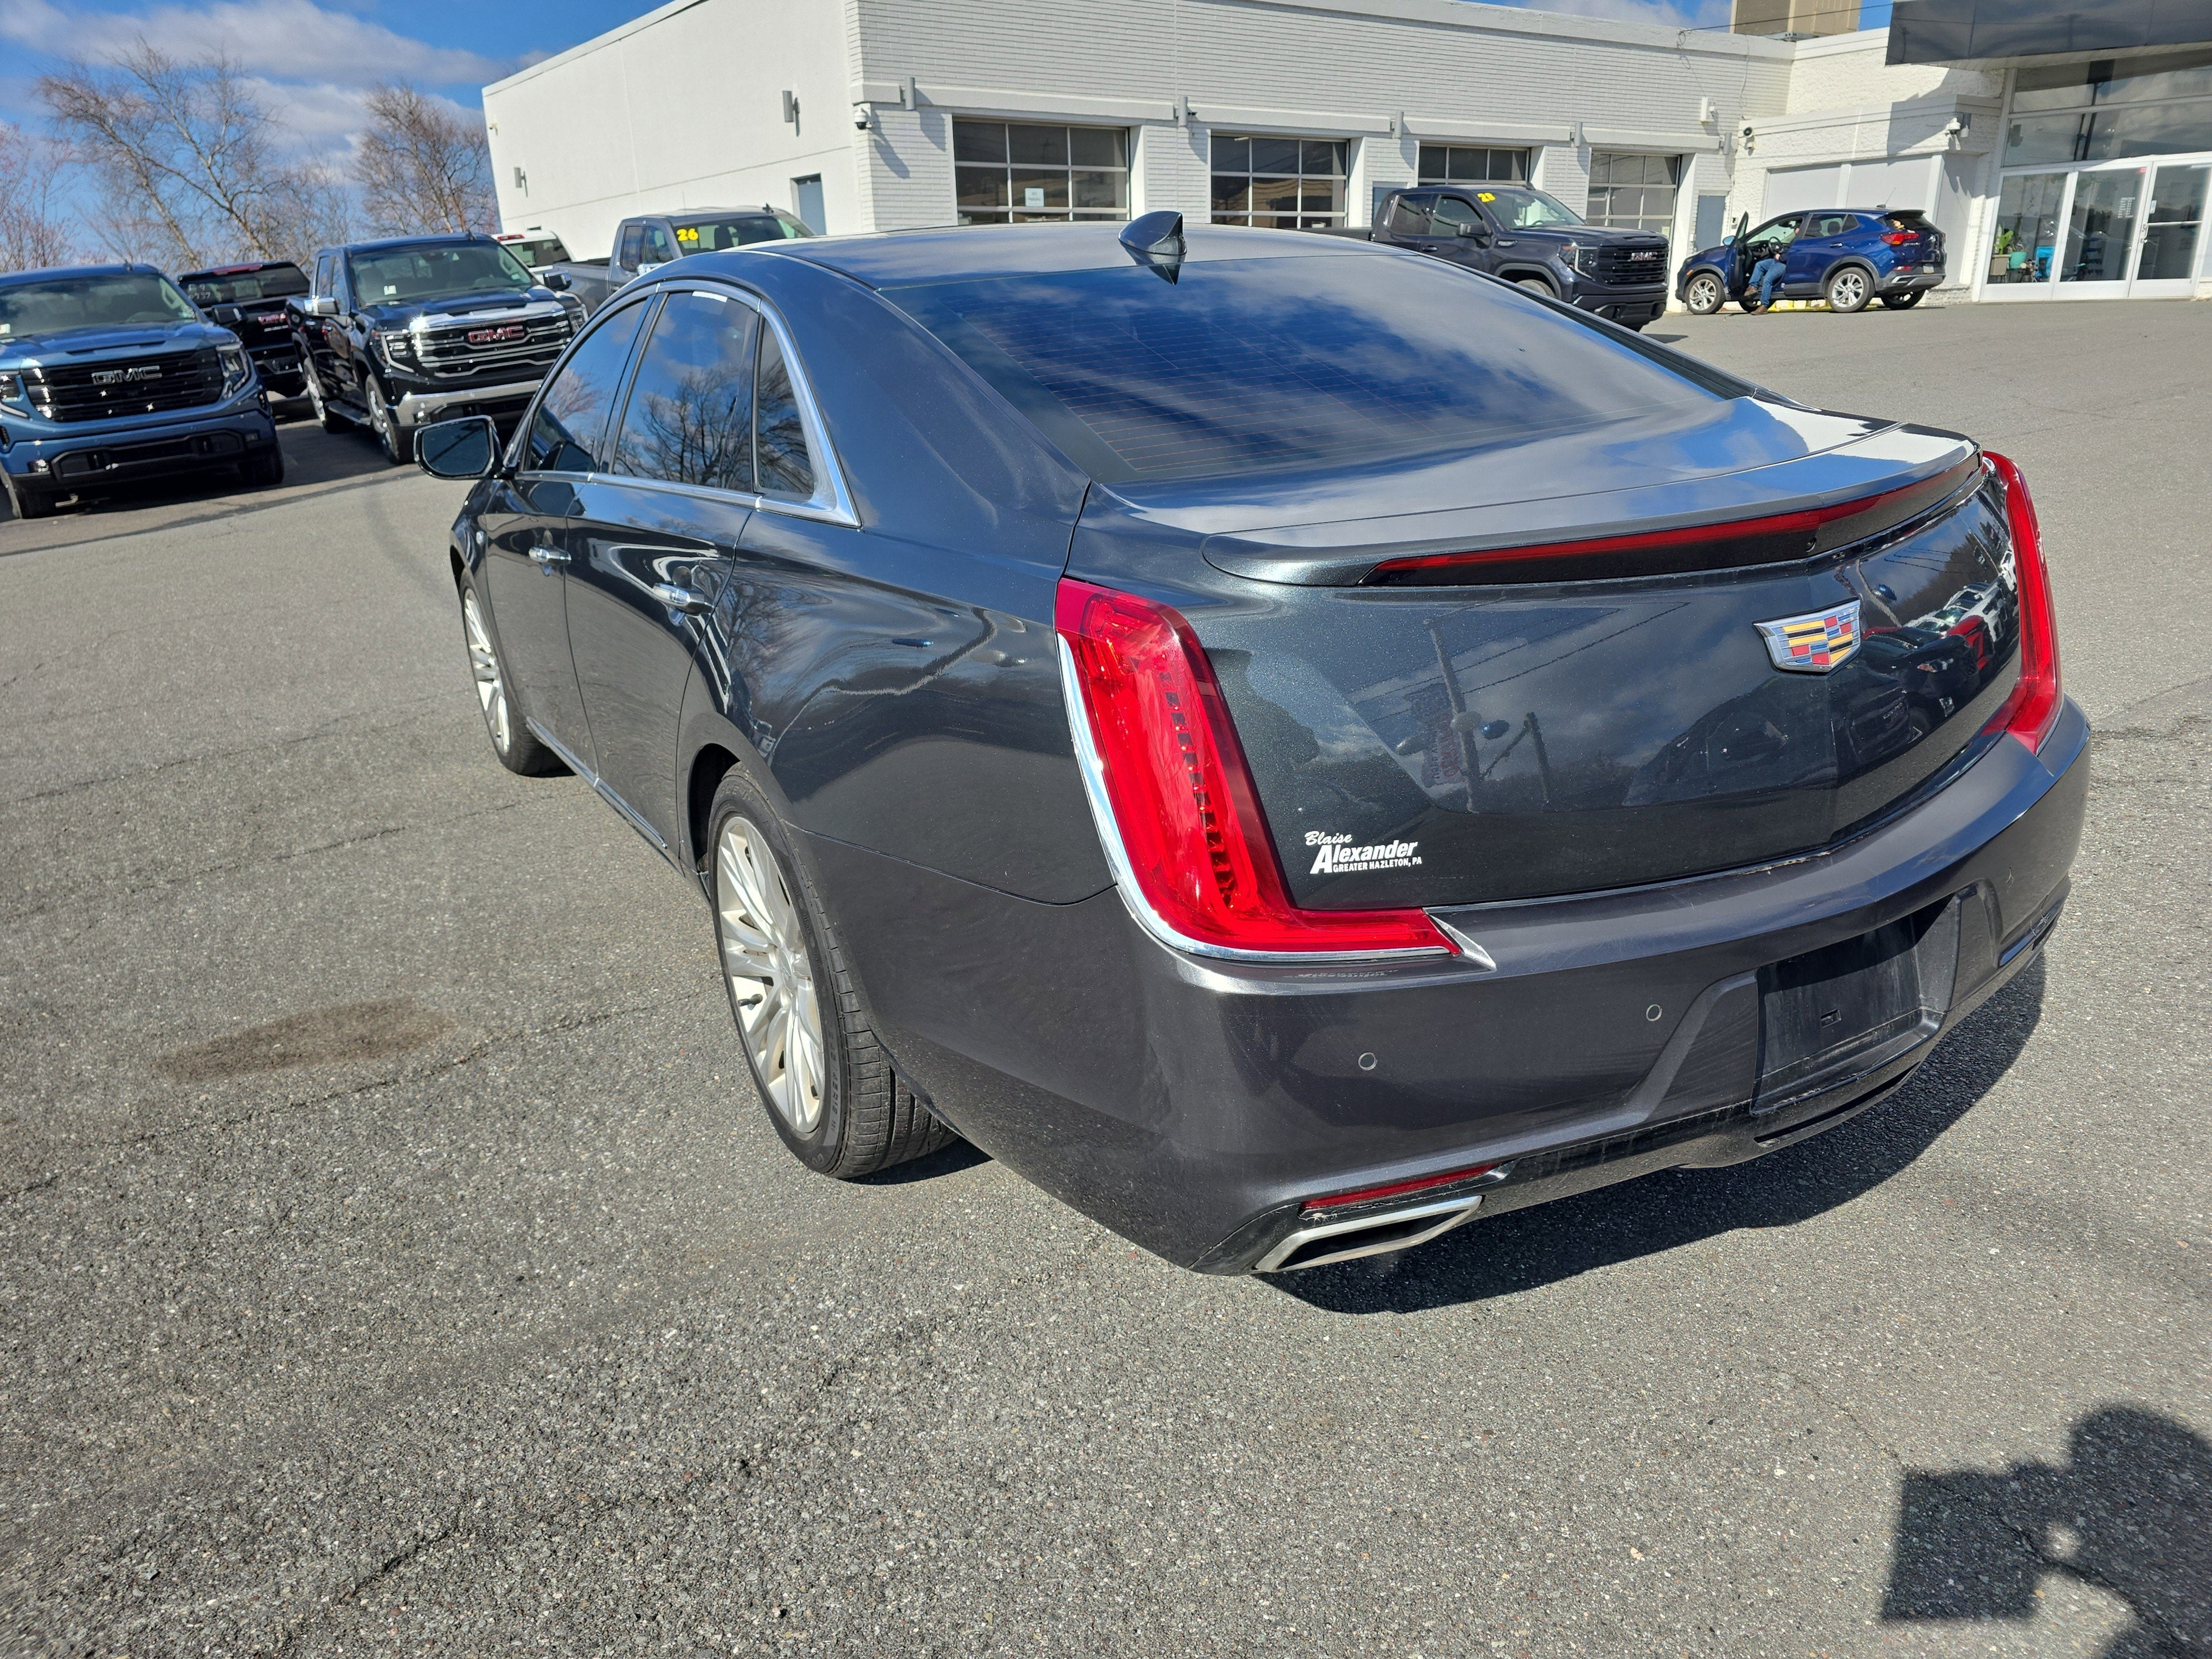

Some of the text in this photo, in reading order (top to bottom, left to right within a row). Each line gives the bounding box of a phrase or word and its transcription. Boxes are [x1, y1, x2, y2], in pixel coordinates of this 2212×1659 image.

[677, 228, 698, 241] 26
[1631, 252, 1658, 261] GMC
[467, 325, 525, 343] GMC
[91, 365, 162, 385] GMC
[1304, 831, 1353, 846] Blaise
[1310, 840, 1418, 874] Alexander
[1333, 857, 1422, 873] GREATER HAZLETON, PA
